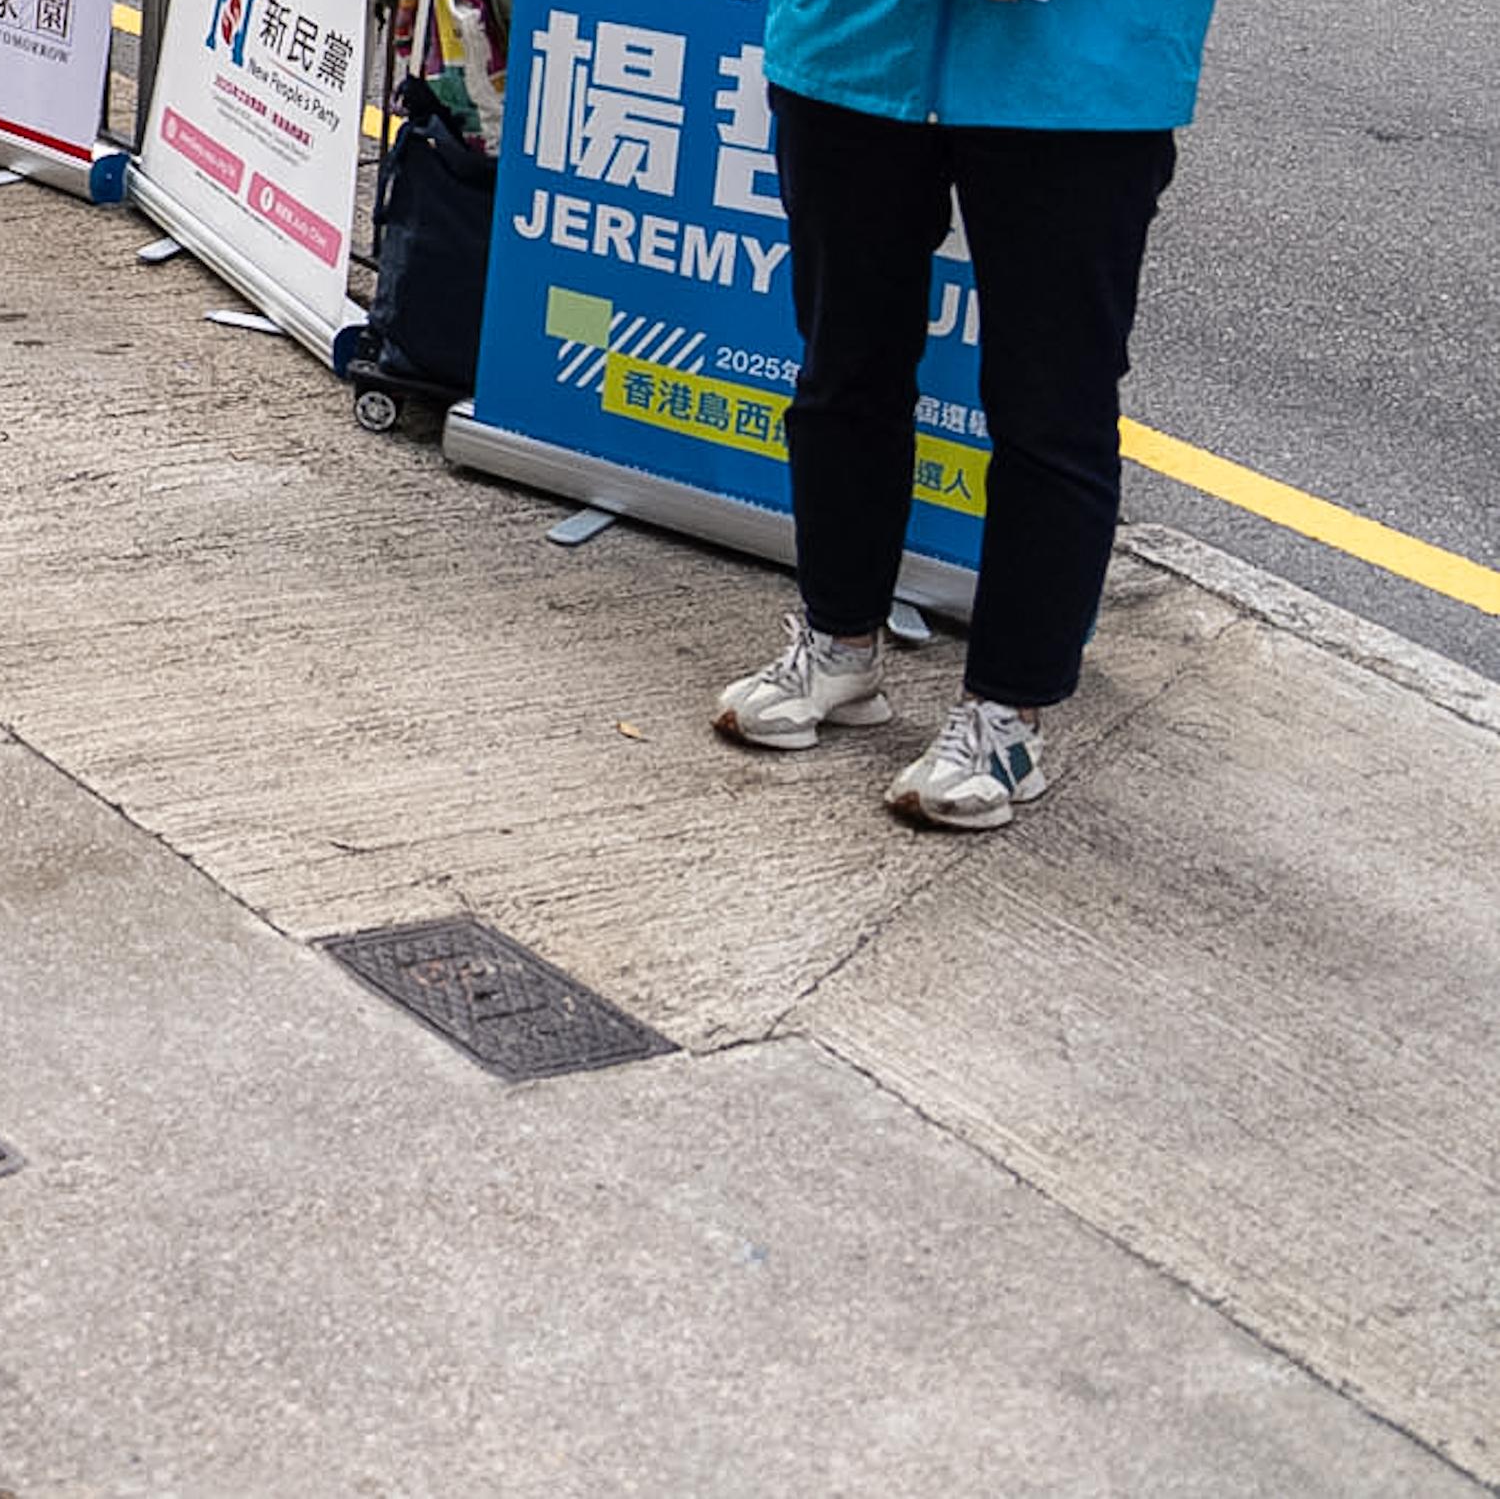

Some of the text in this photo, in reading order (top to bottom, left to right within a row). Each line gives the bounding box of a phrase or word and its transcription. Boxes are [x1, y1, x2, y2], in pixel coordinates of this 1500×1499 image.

[249, 58, 269, 84] New
[308, 98, 341, 134] Party
[512, 188, 792, 295] JEREMY
